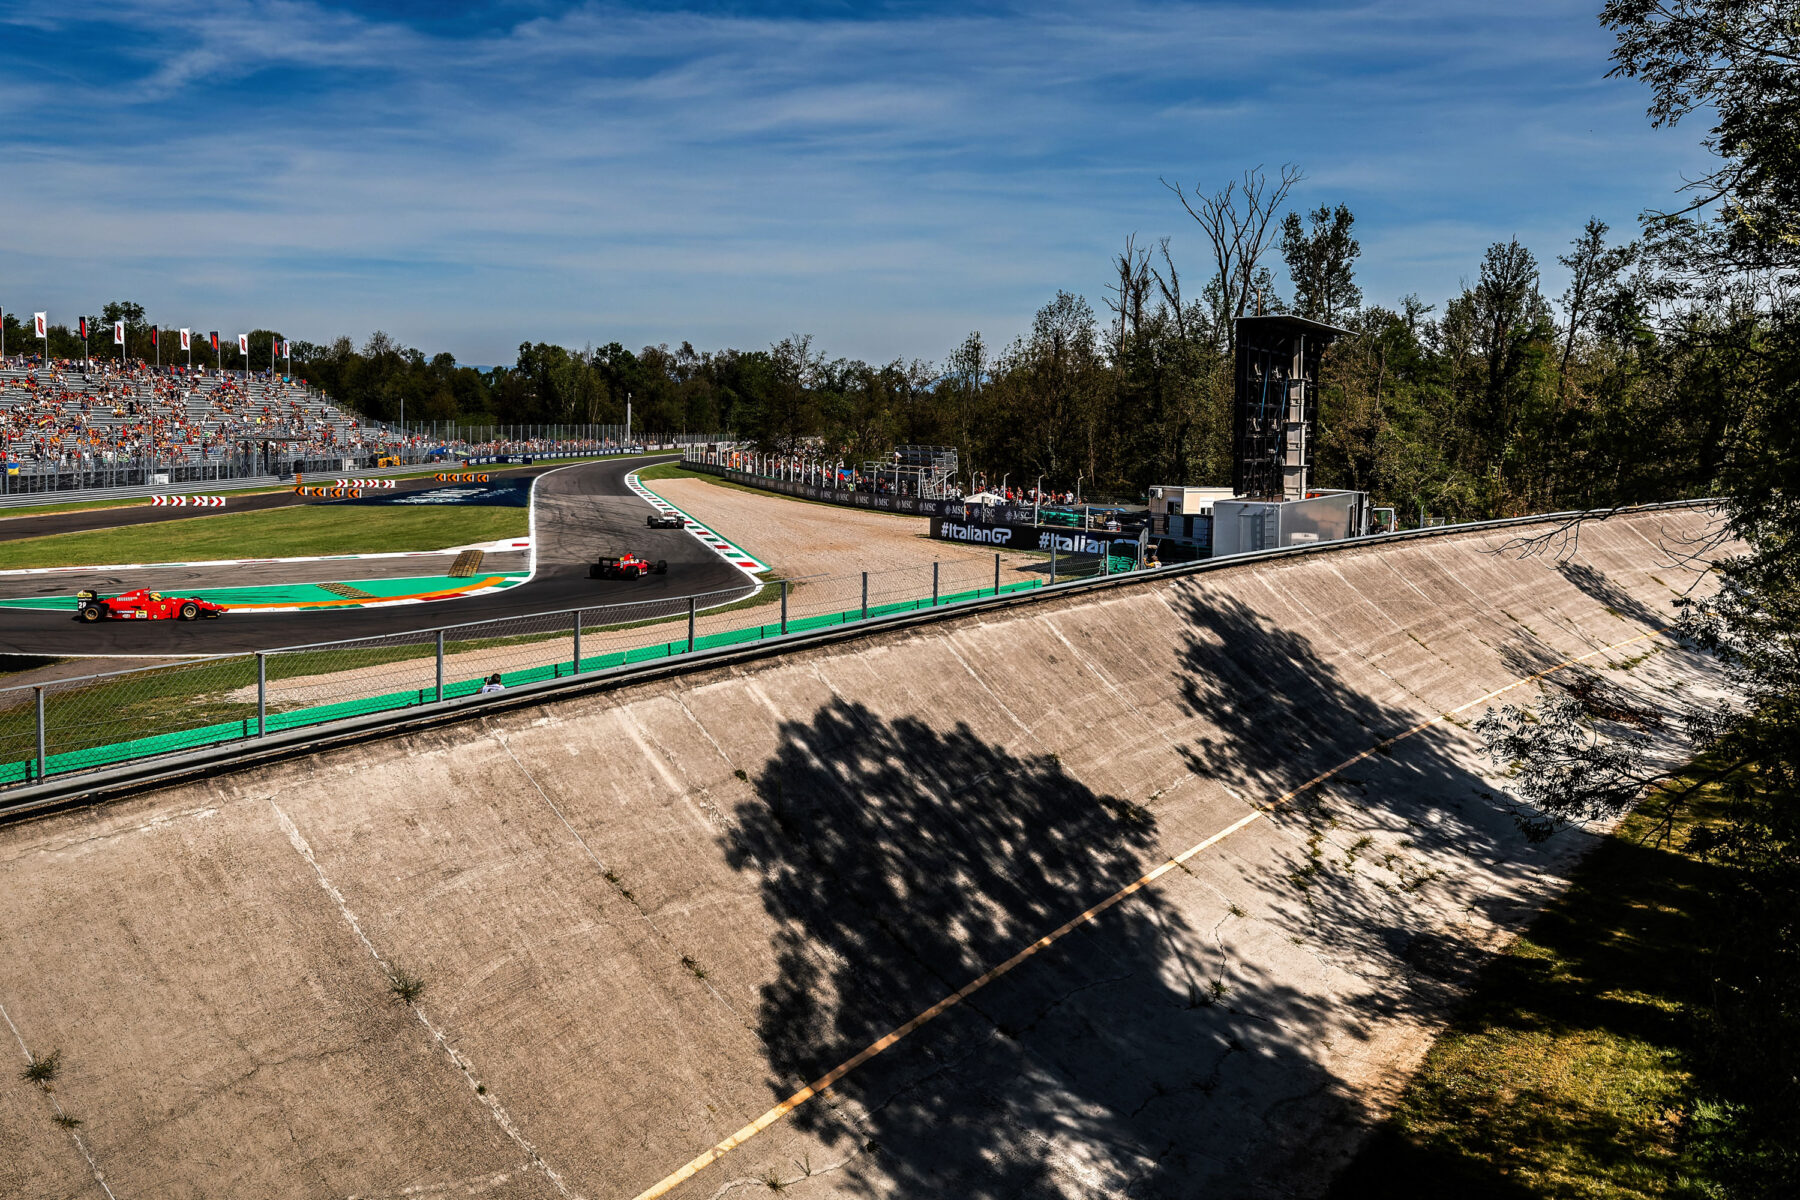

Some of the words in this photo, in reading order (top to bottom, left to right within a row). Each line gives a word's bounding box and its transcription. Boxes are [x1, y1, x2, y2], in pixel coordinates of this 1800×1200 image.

[879, 498, 889, 507] MSC
[901, 500, 912, 509] MSC
[923, 502, 936, 512] MSC
[941, 522, 1012, 544] #ItalianGP
